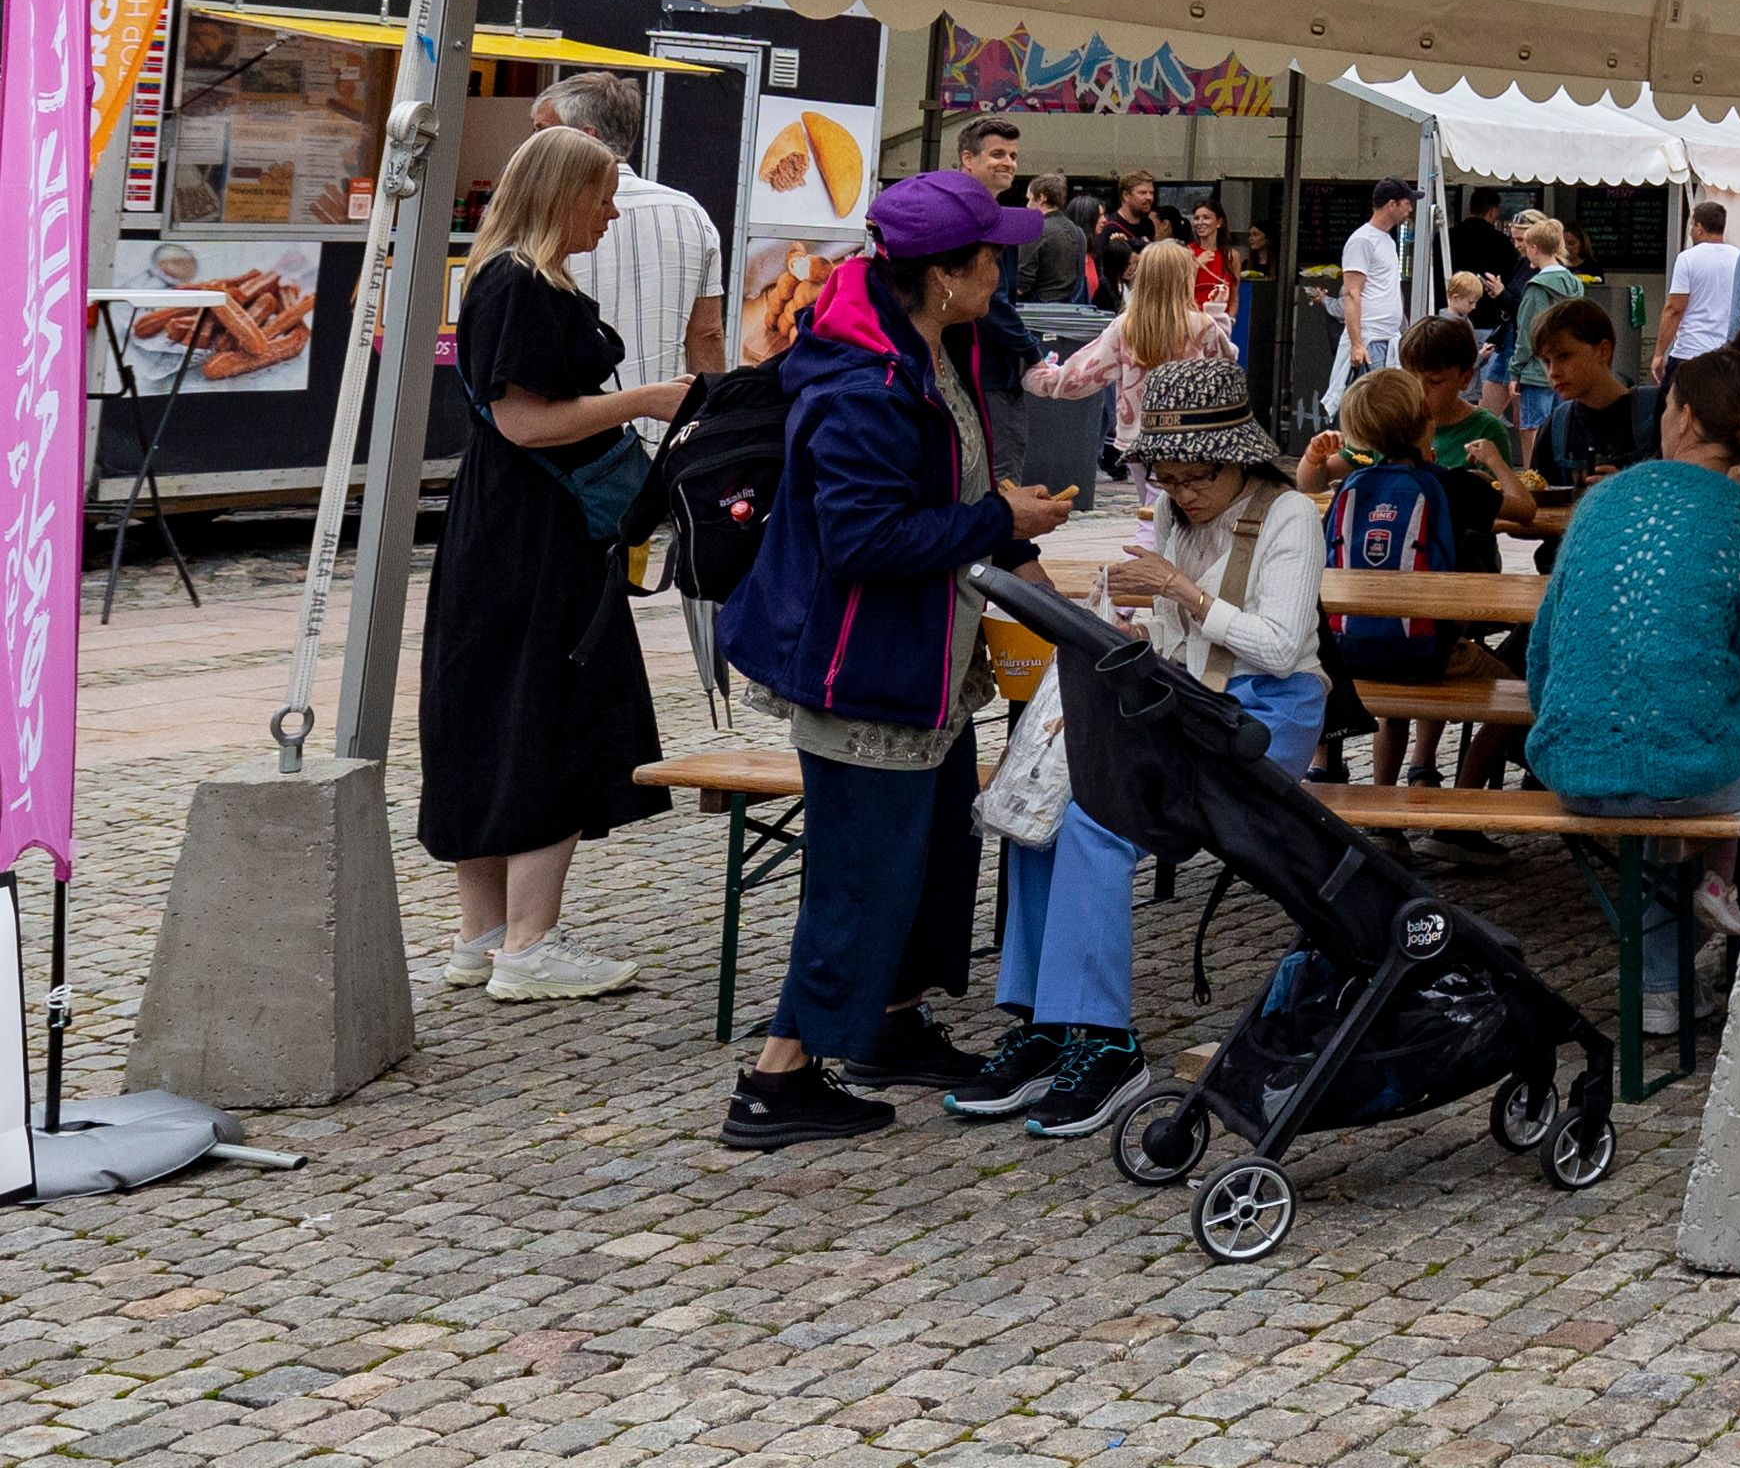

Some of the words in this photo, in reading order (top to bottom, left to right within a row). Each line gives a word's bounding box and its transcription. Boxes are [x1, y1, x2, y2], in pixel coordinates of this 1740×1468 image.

[1159, 414, 1182, 426] DIOR
[1407, 918, 1434, 935] baby
[1406, 930, 1443, 948] jogger
